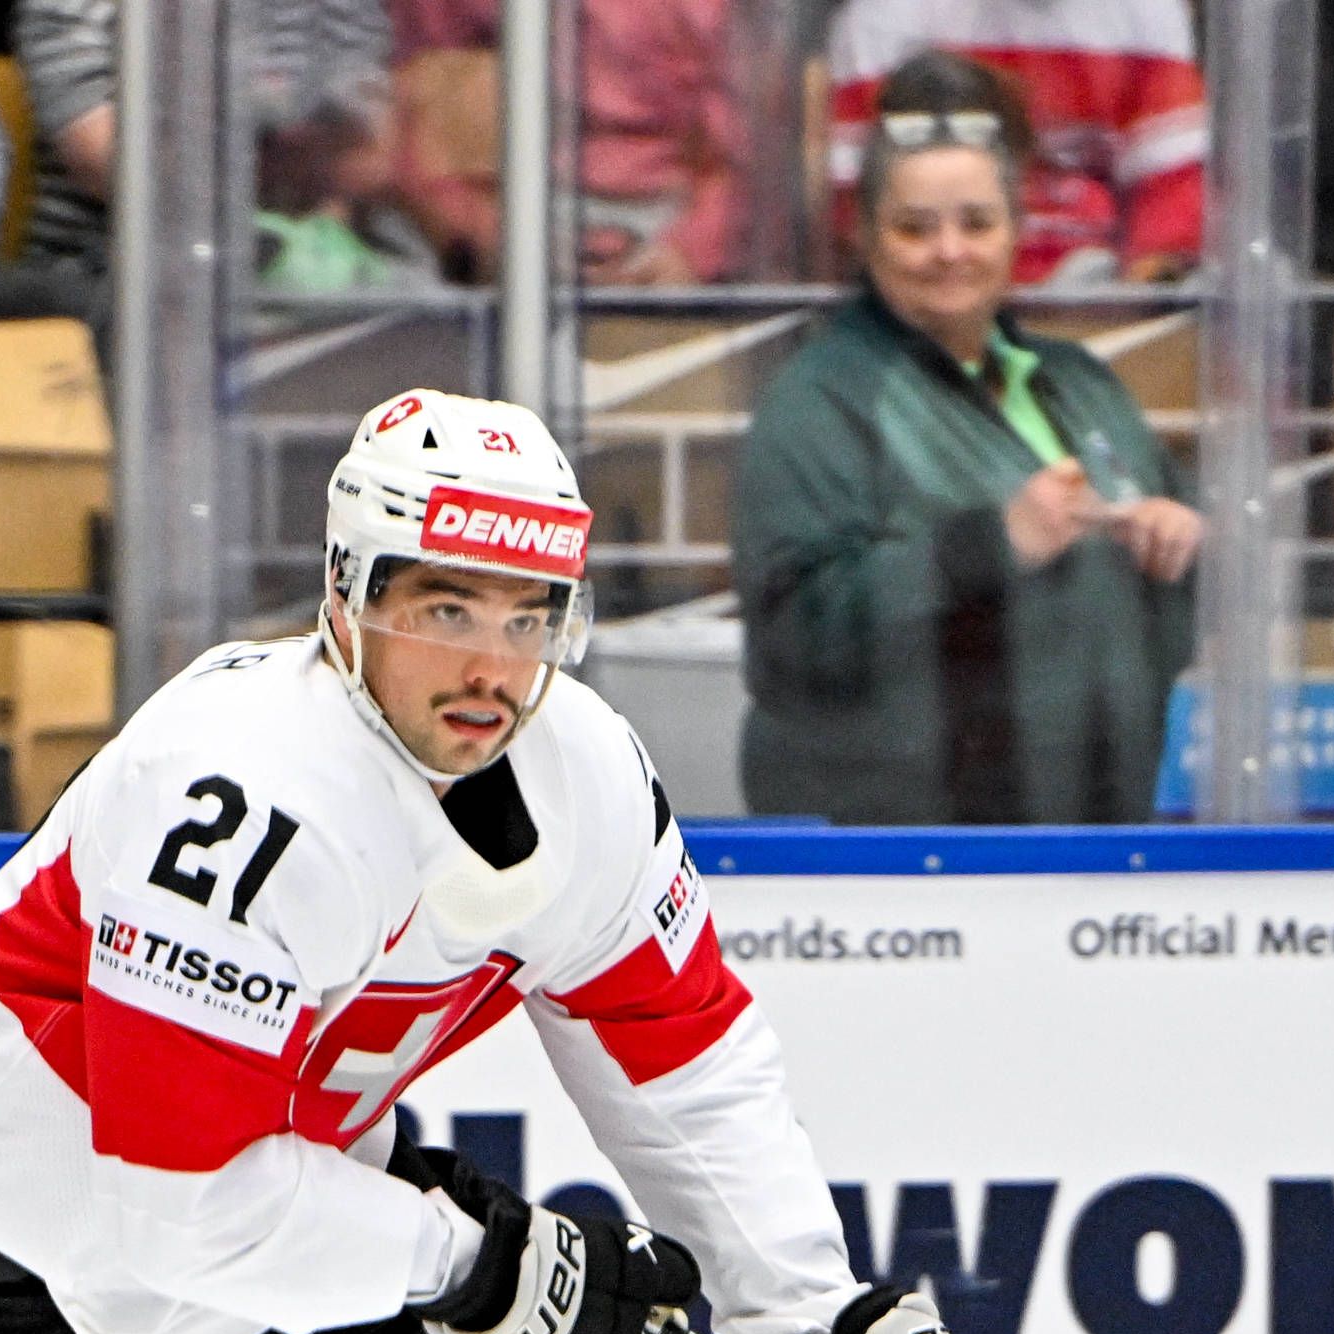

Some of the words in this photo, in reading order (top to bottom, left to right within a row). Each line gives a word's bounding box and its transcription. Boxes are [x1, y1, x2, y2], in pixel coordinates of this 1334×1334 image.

[478, 428, 520, 454] 21
[430, 503, 585, 560] DENNER
[147, 774, 301, 926] 21
[1070, 914, 1235, 957] Official
[95, 949, 120, 970] SWISS
[125, 963, 195, 998] WATCHES
[203, 994, 250, 1018] SINCE
[144, 930, 297, 1011] TISSOT
